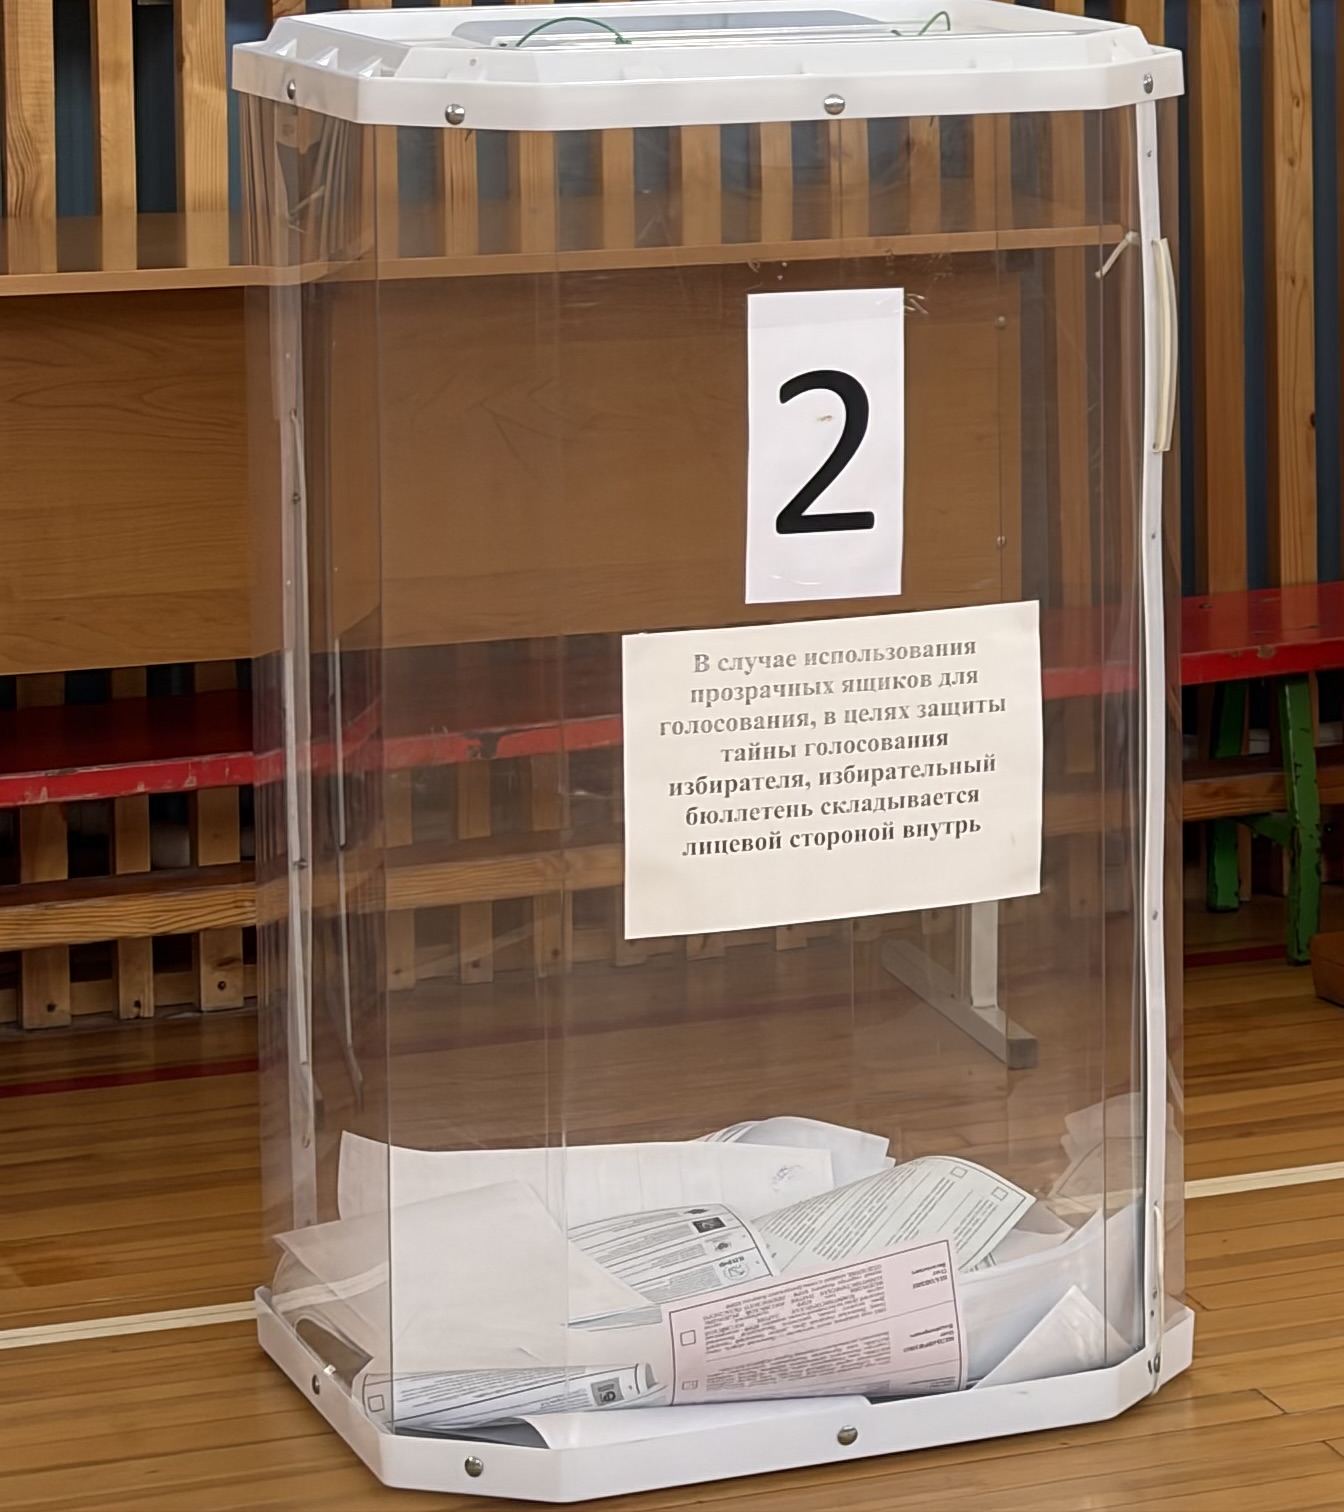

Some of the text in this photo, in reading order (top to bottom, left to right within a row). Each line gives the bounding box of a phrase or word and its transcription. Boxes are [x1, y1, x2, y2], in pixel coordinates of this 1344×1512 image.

[775, 369, 875, 535] 2
[693, 641, 977, 676] В случае использования
[690, 669, 979, 709] прозрачных ящиков для
[659, 697, 1006, 737] голосования, в целях защиты
[719, 732, 949, 763] тайны голосования
[668, 753, 996, 799] избирателя, избирательный
[685, 788, 980, 826] бюллетень складывается
[681, 818, 982, 857] лицевой стороной внутрь
